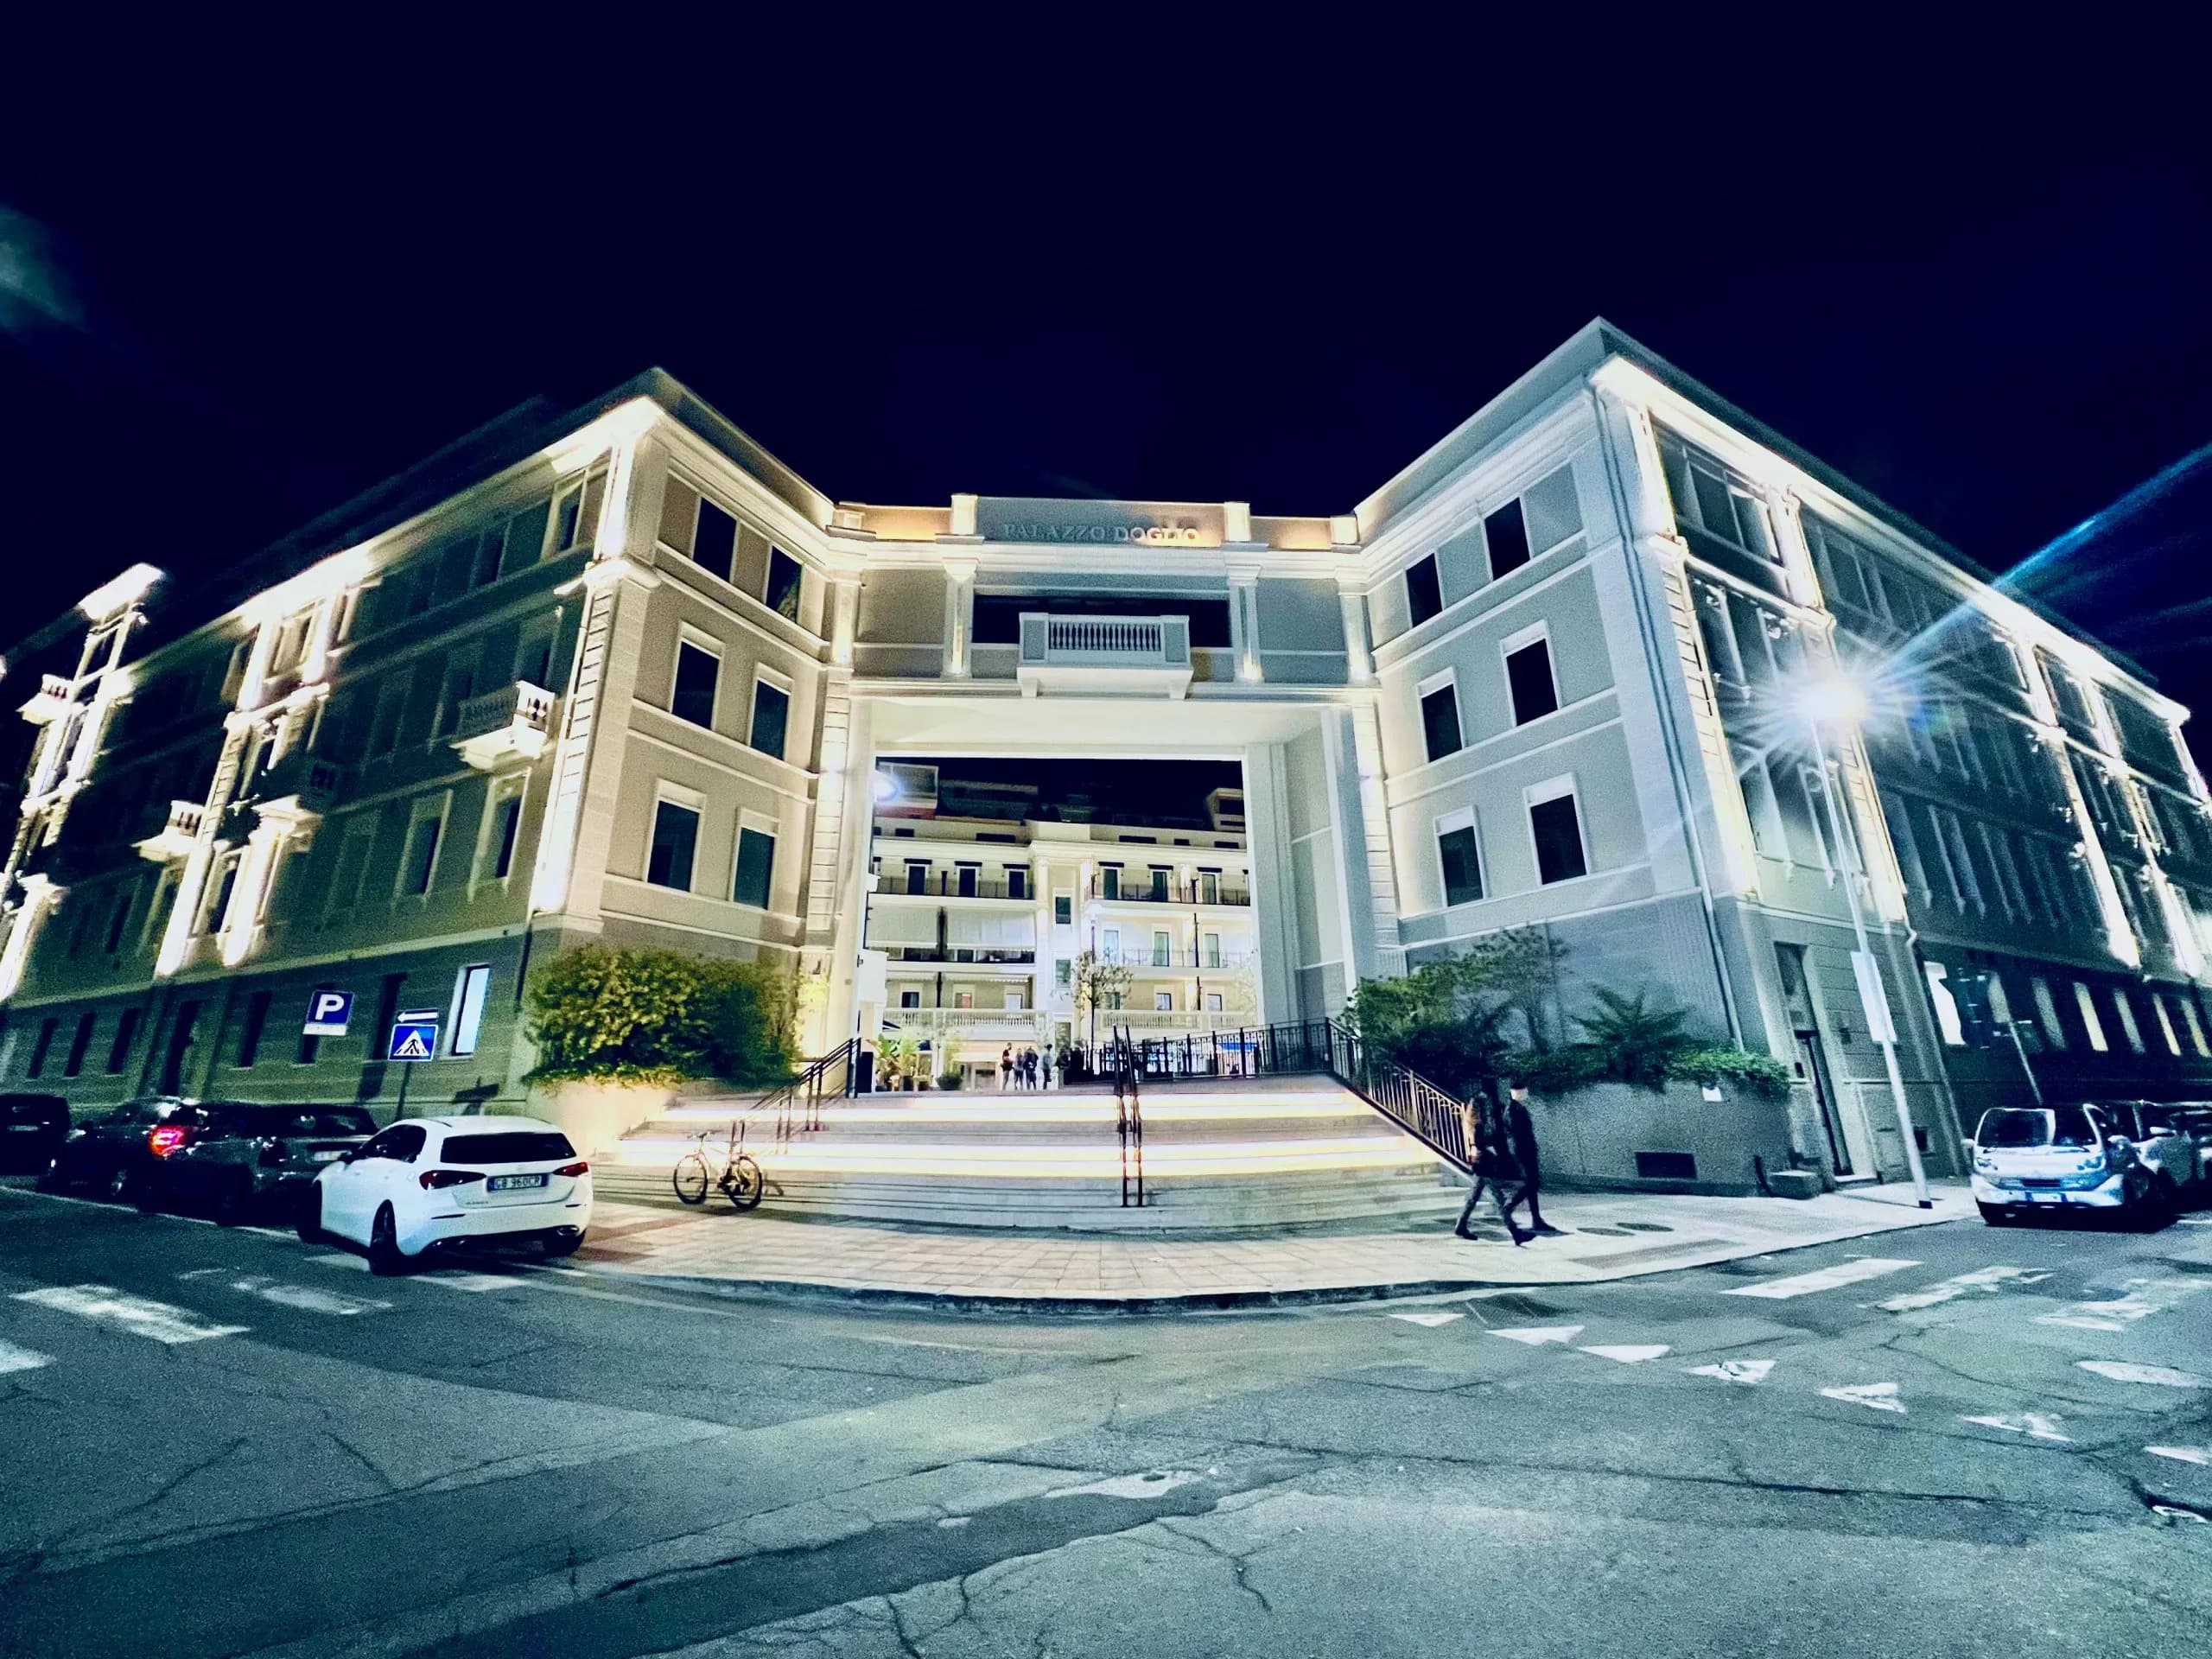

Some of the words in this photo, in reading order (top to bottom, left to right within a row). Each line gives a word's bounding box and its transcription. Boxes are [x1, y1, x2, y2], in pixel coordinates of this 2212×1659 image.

[1003, 524, 1106, 541] PALAZZO
[1115, 526, 1200, 542] DOGLIO
[315, 994, 345, 1020] P
